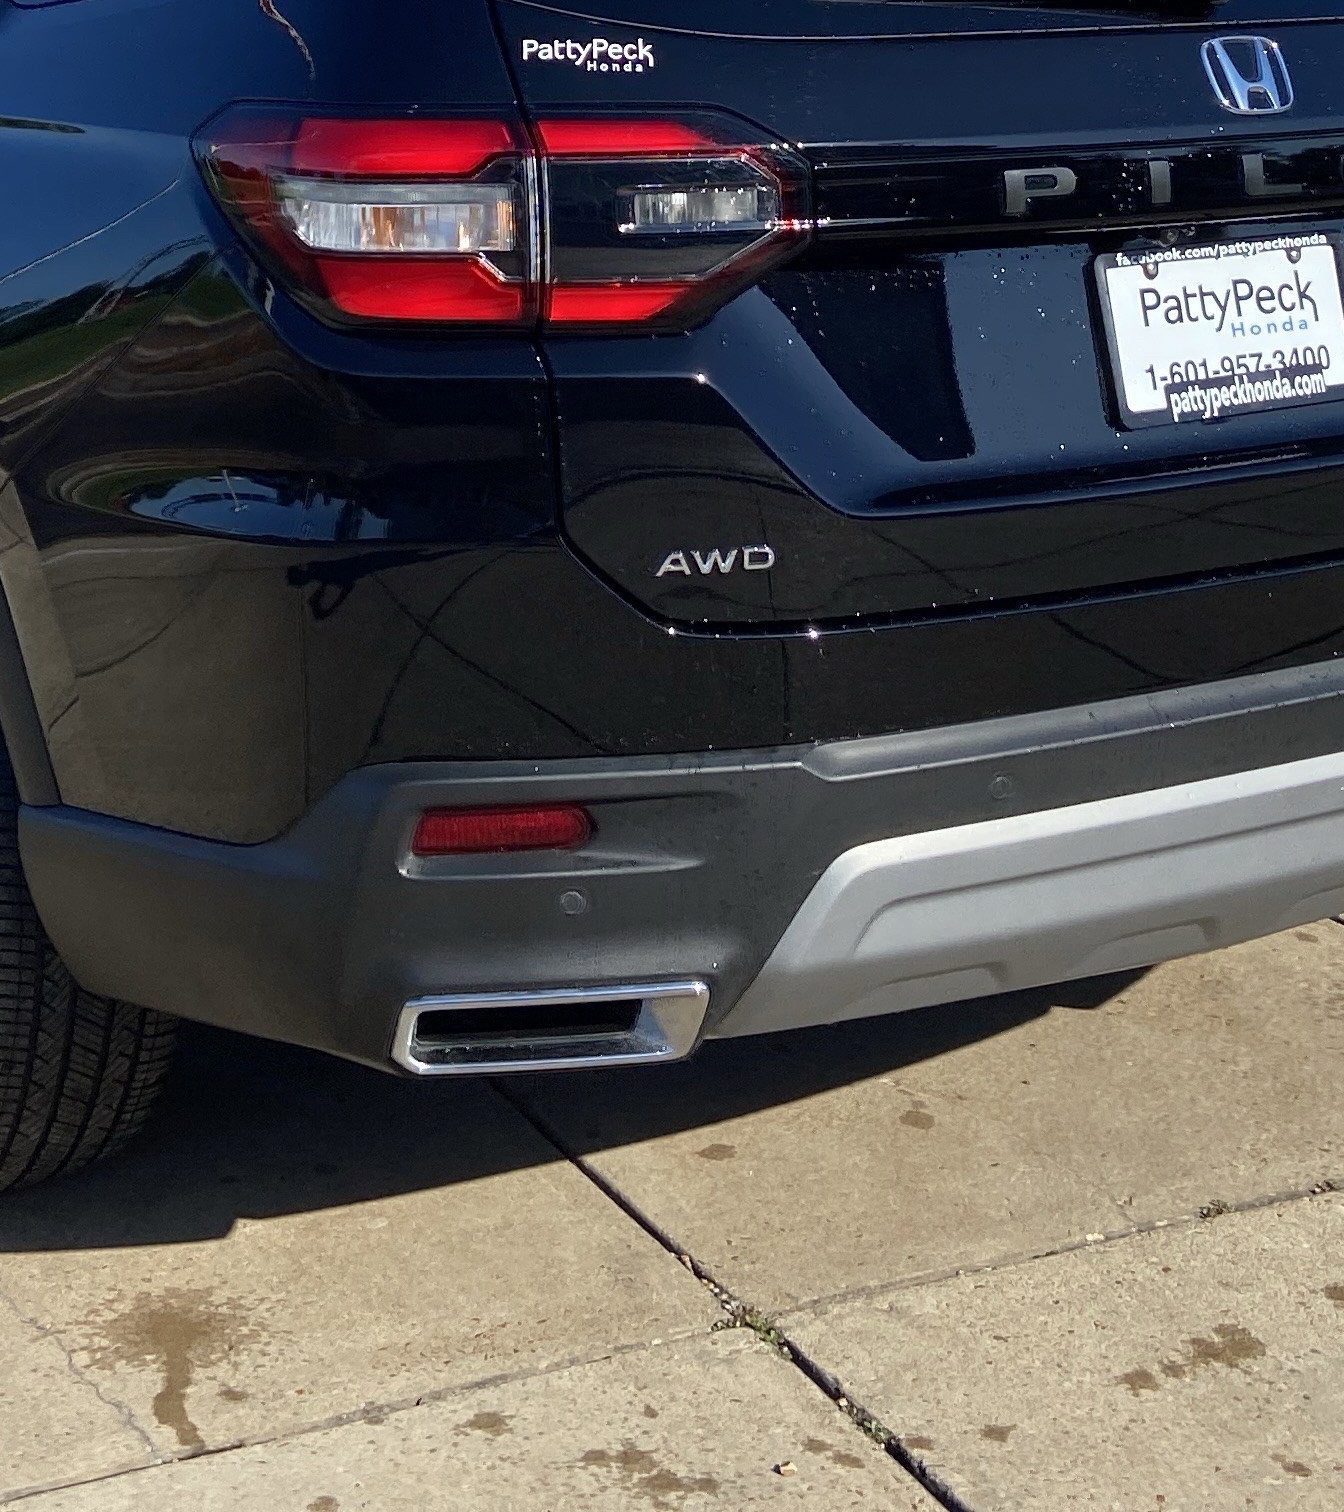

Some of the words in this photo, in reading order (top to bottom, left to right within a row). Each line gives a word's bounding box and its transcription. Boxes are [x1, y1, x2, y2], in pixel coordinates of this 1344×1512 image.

[522, 38, 655, 68] PattyPeck
[586, 60, 644, 73] Honda
[1138, 269, 1320, 333] PattyPeck
[1231, 317, 1309, 338] Honda
[1144, 344, 1331, 391] 1-601-957-3400
[1169, 369, 1327, 423] pattypeckhonda.com
[656, 544, 776, 577] AWD
